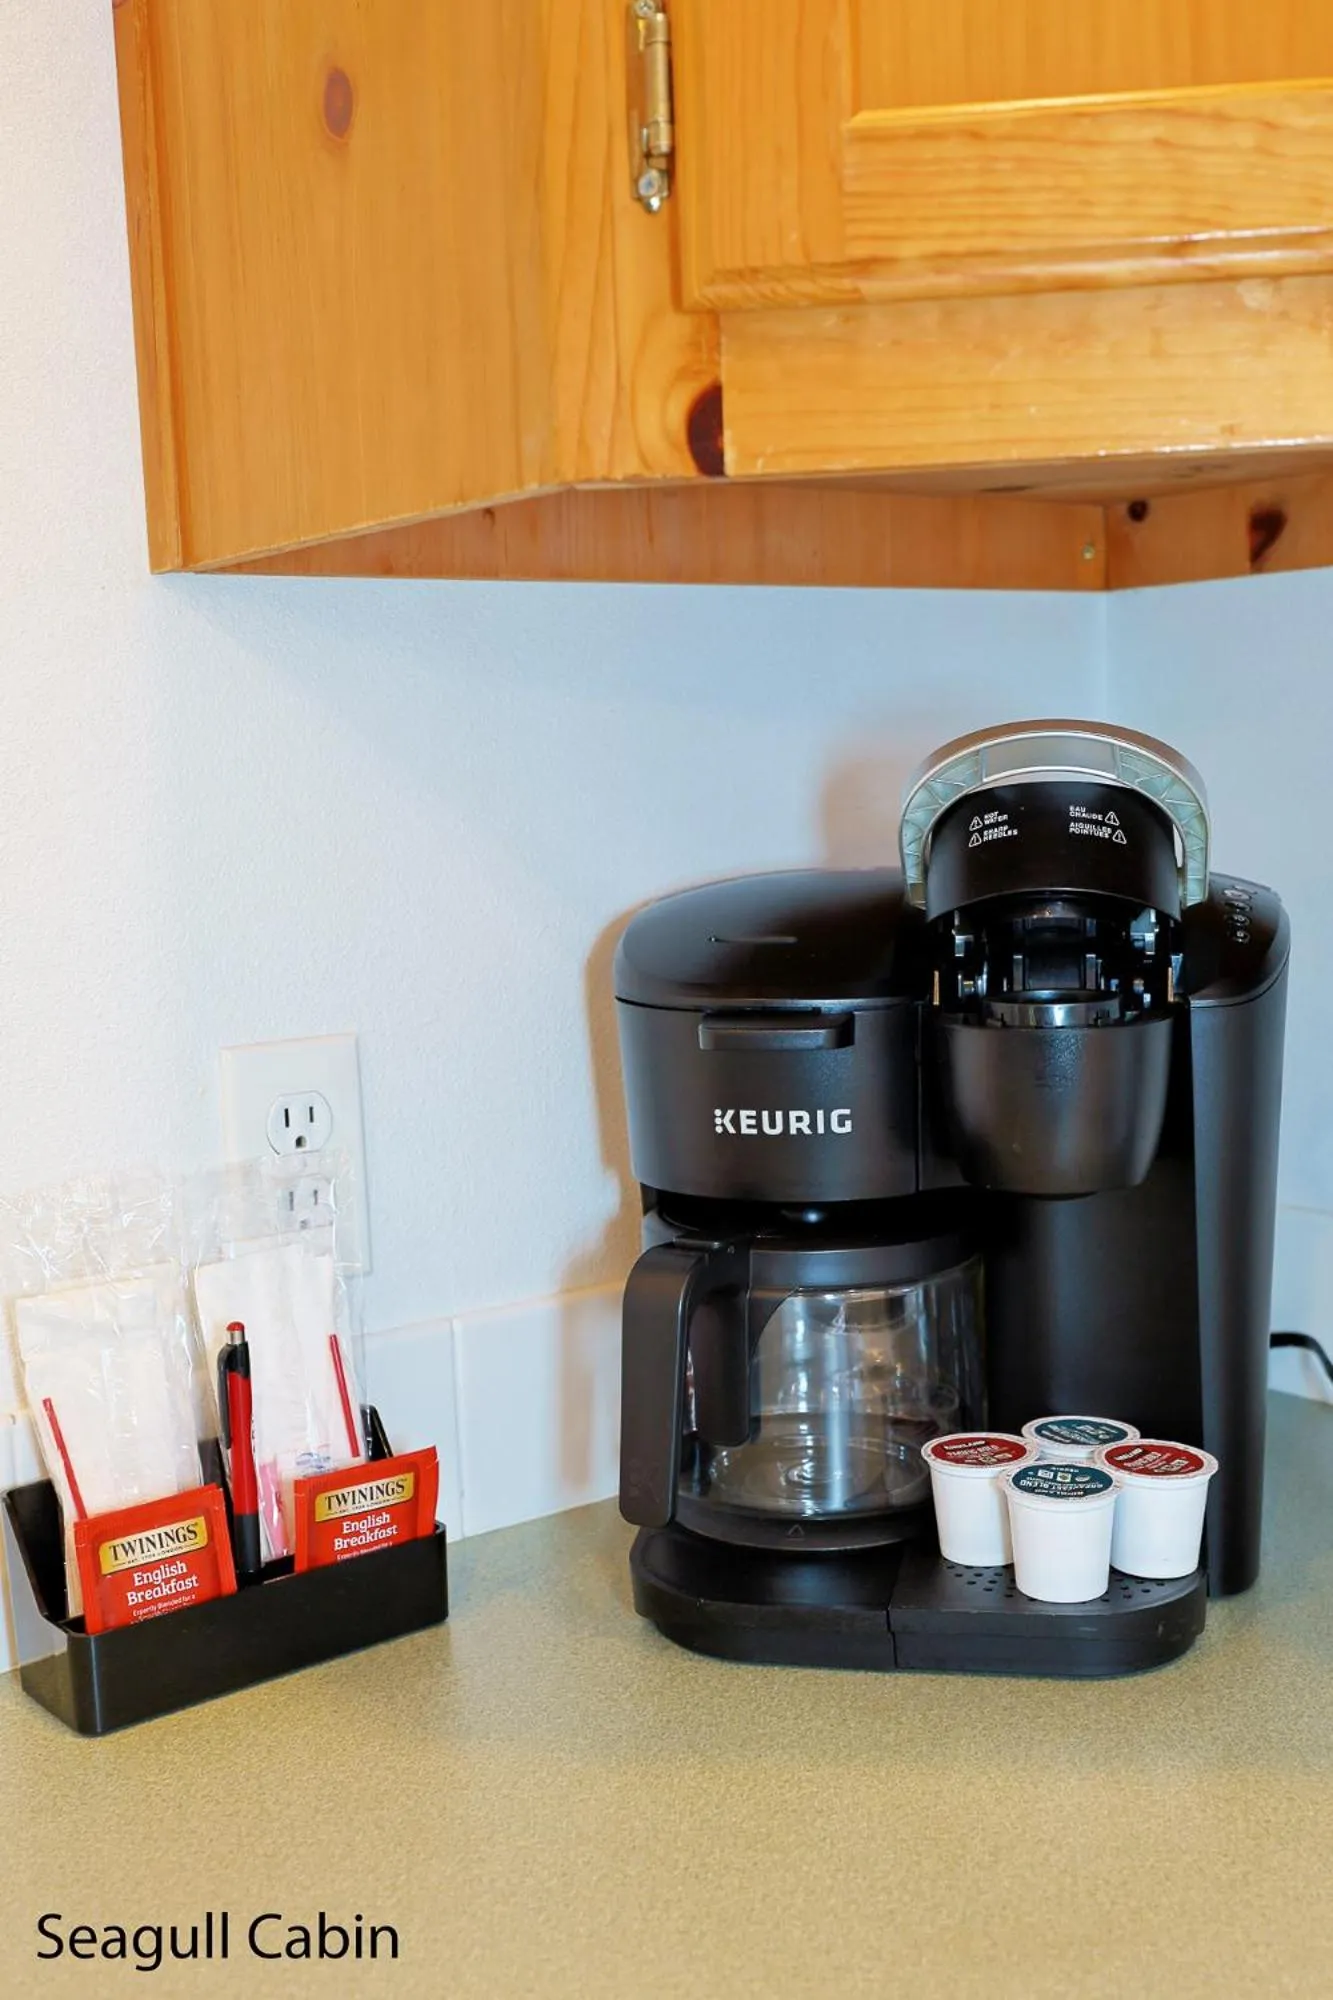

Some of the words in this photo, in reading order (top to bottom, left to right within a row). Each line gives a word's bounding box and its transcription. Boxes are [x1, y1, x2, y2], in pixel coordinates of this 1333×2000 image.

[1069, 811, 1103, 821] CHAUDE
[983, 829, 1018, 842] NEEDLES
[714, 1108, 853, 1136] KEURIG
[324, 1480, 405, 1511] TWININGS
[342, 1511, 391, 1534] English
[108, 1523, 198, 1561] TWININGS
[334, 1525, 398, 1551] Breakfast
[133, 1560, 188, 1586] English
[126, 1574, 200, 1607] Breakfast
